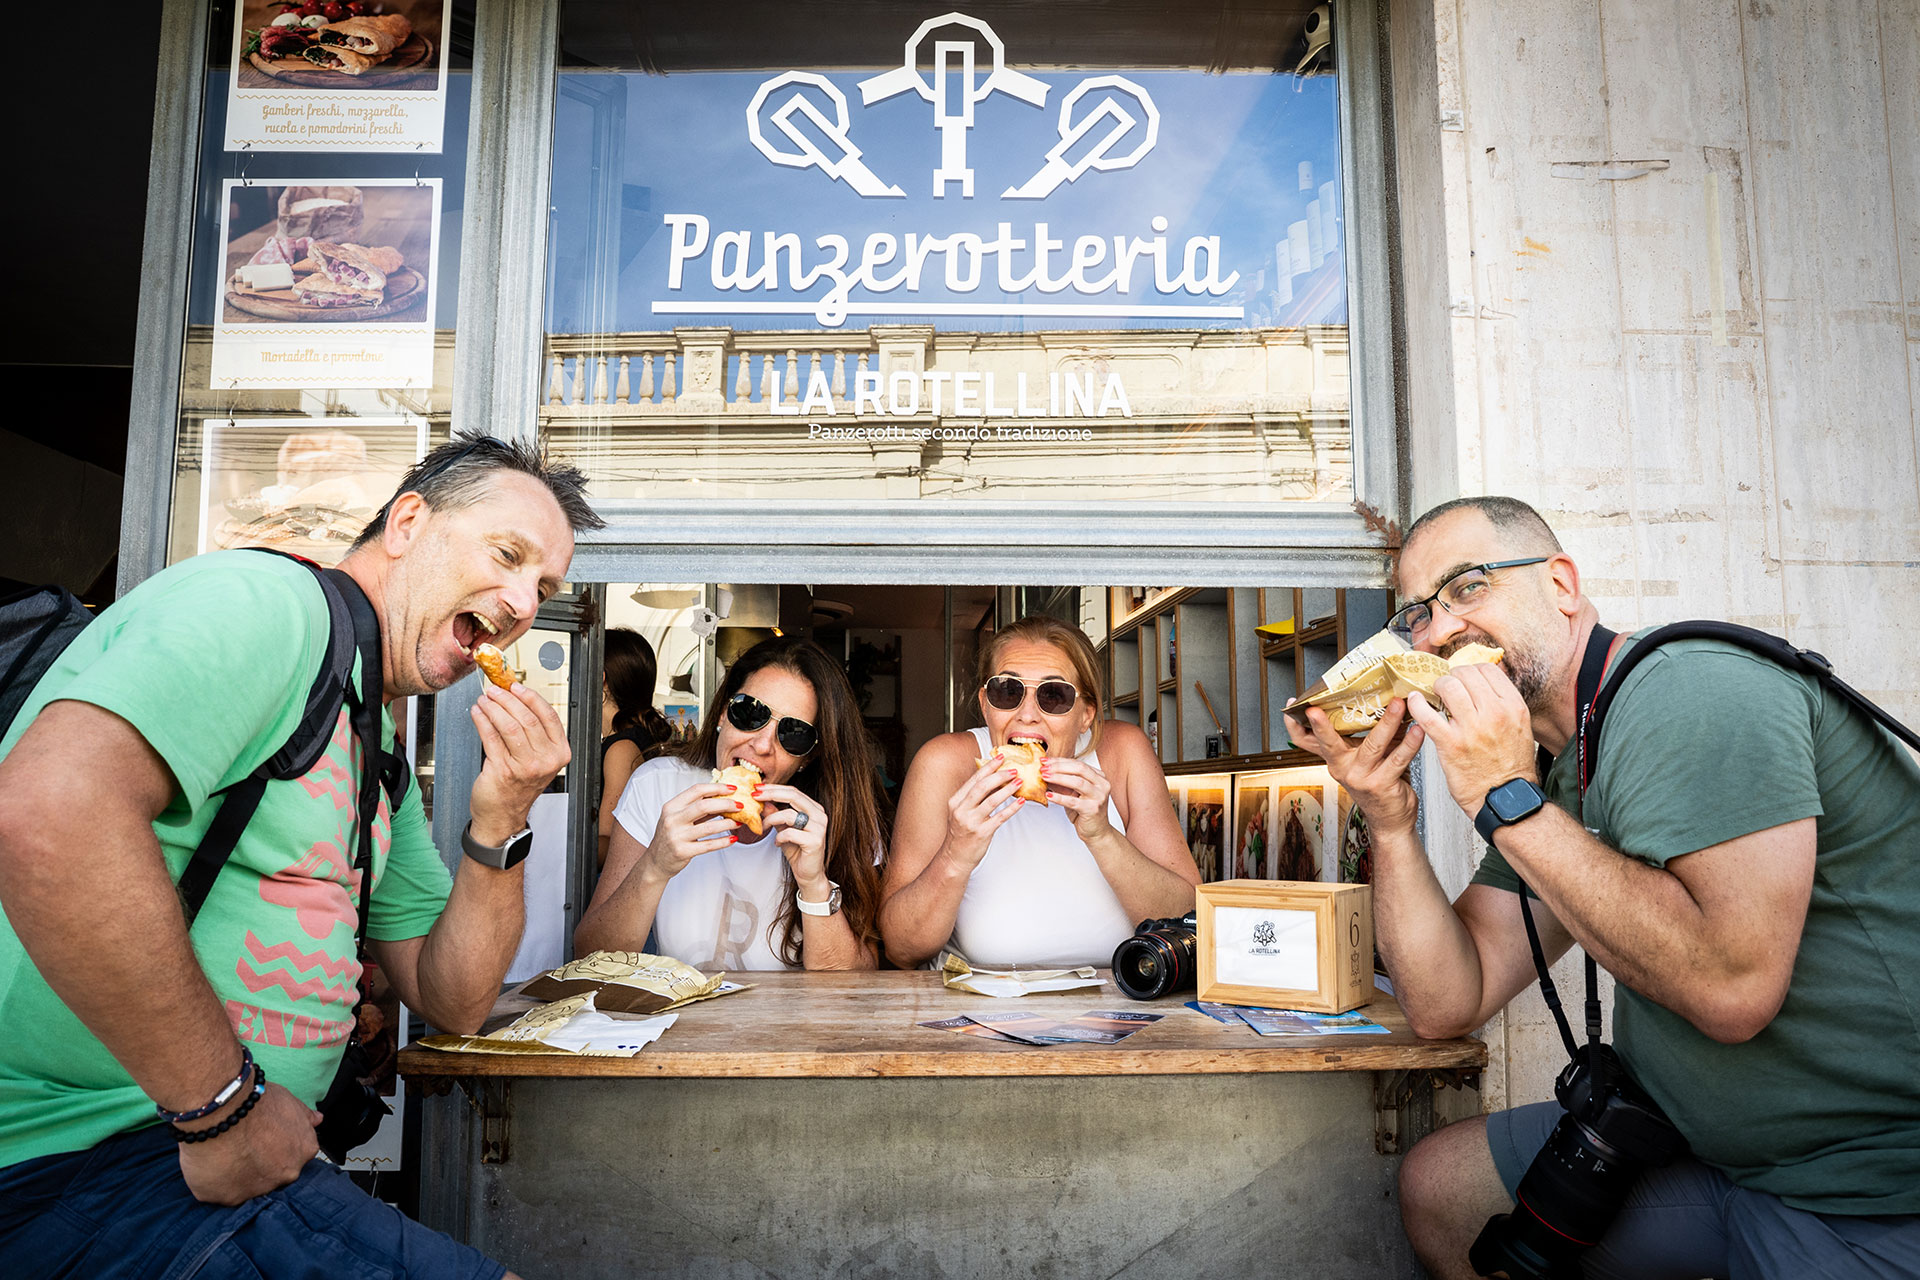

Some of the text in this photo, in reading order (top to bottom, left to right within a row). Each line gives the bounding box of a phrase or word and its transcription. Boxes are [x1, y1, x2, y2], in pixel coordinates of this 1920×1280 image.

[262, 103, 408, 121] Gamberi freschi, mozzarella,
[265, 120, 403, 138] rucola e pomodorini freschi
[663, 213, 1240, 327] Panzerotteria
[260, 347, 384, 366] Mortadella e provolone
[770, 370, 1133, 418] LA ROTELLINA
[808, 423, 1092, 442] Panzerotti secondo tradizione
[1349, 911, 1360, 948] 6
